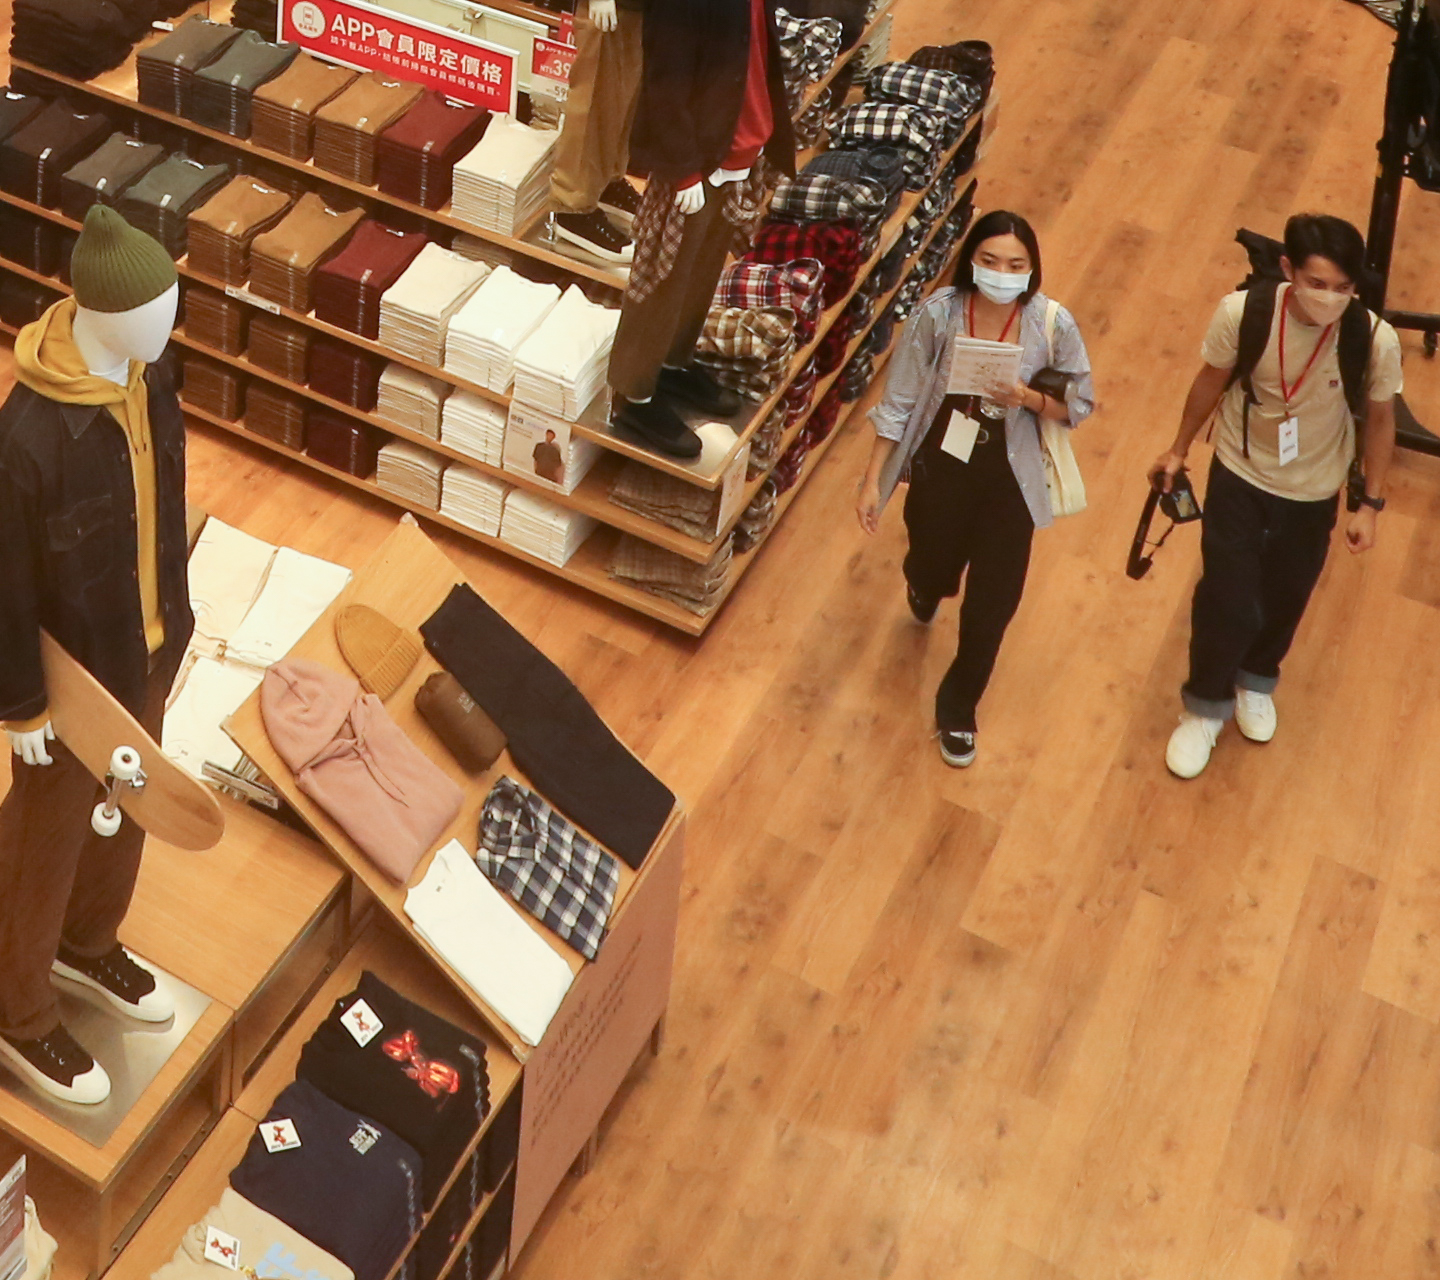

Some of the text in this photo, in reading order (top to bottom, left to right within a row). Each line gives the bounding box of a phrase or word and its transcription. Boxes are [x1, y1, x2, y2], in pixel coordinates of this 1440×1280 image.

[330, 13, 504, 85] APP會員限定價格
